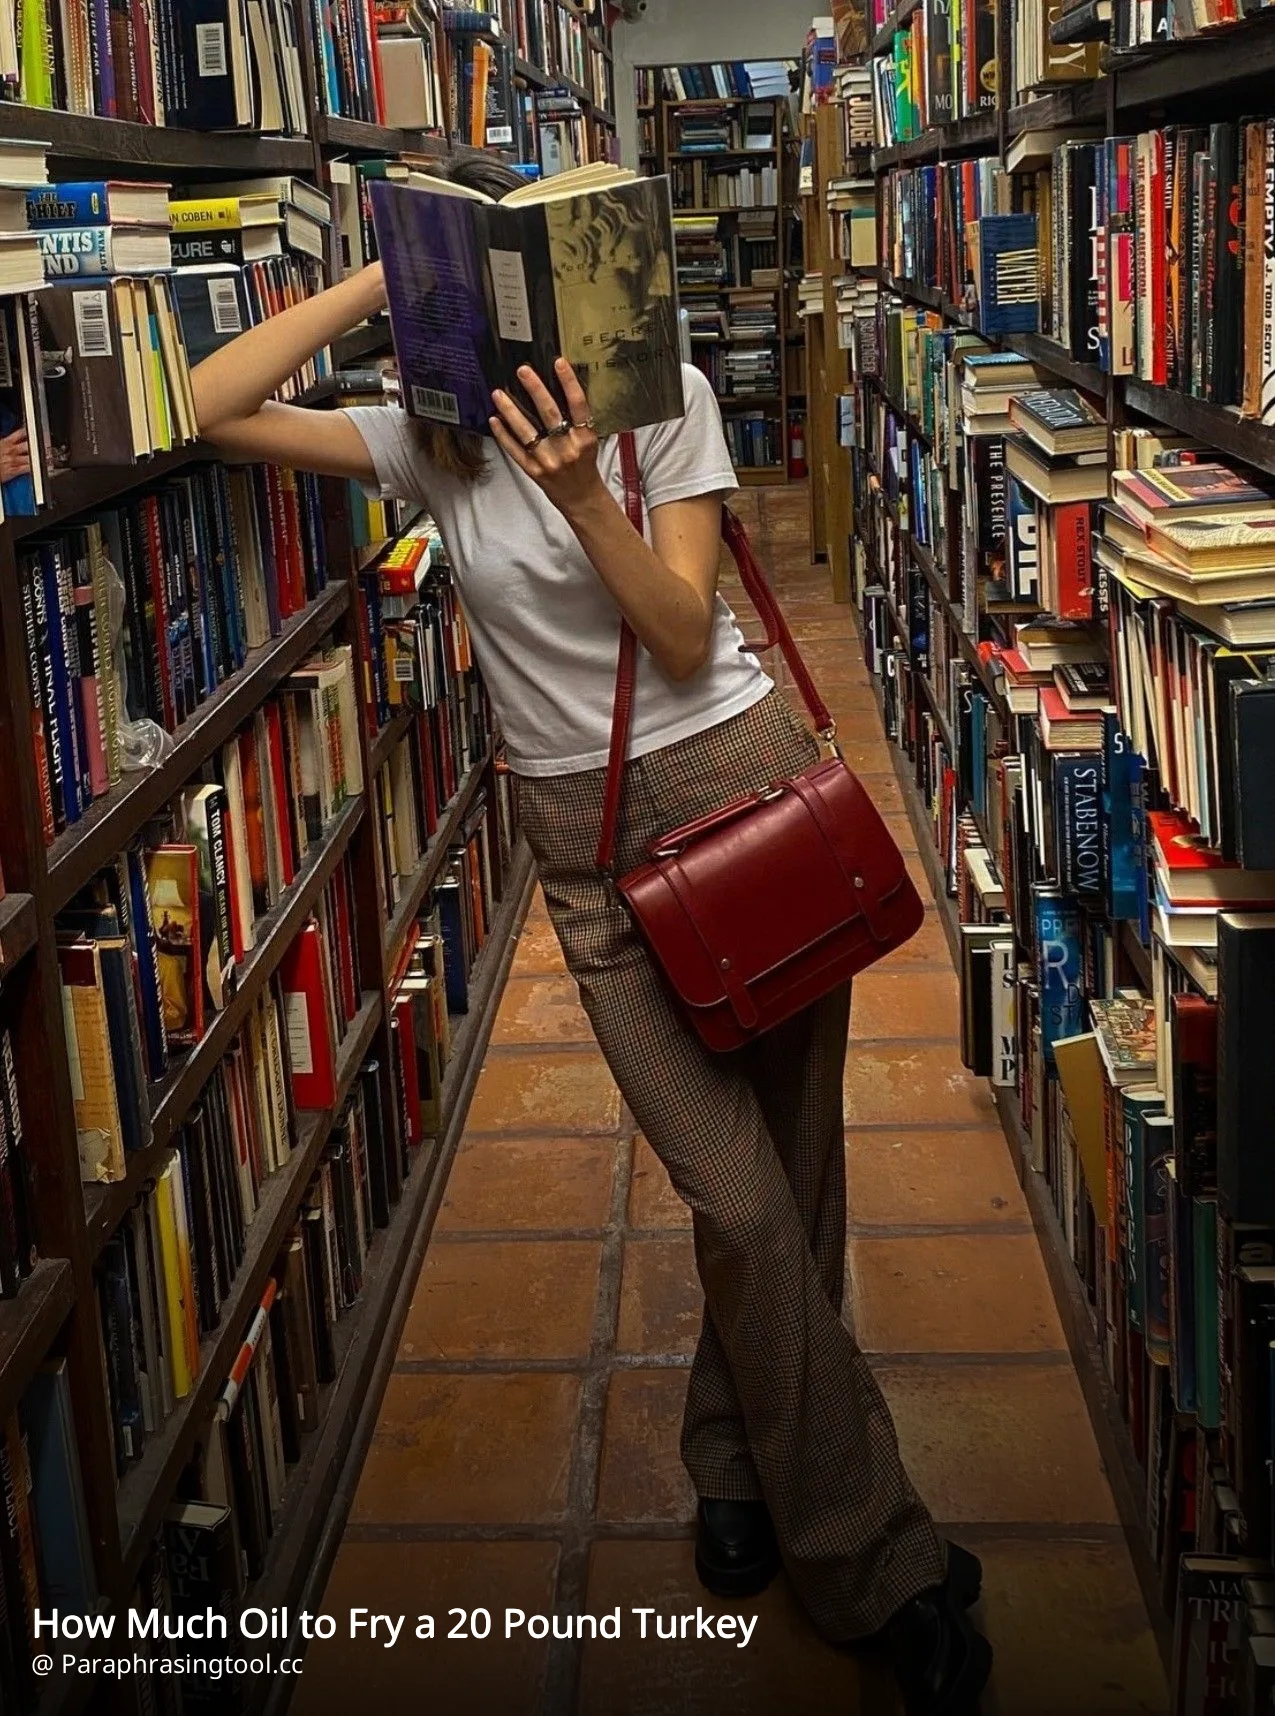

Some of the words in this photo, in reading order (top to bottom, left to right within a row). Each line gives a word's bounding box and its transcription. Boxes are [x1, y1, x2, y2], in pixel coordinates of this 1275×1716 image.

[848, 96, 875, 148] JUDGE
[1164, 174, 1173, 210] SMITH
[1264, 167, 1275, 251] EMPTY
[181, 210, 213, 223] COBEN
[38, 230, 94, 255] NTIS
[1264, 283, 1273, 319] TODD
[582, 321, 659, 347] SECRE
[1264, 323, 1273, 368] SCOTT
[989, 443, 1004, 468] THE
[990, 475, 1006, 540] PRESENCE
[1076, 516, 1086, 542] REX
[1076, 543, 1087, 586] STOUT
[22, 584, 37, 650] STEPHEN
[30, 651, 42, 709] COONTS
[44, 654, 57, 714] FINAL
[50, 717, 64, 784] FLIGHT
[211, 808, 222, 839] TOM
[1073, 767, 1100, 891] STABENOW
[213, 839, 227, 887] CLANCY
